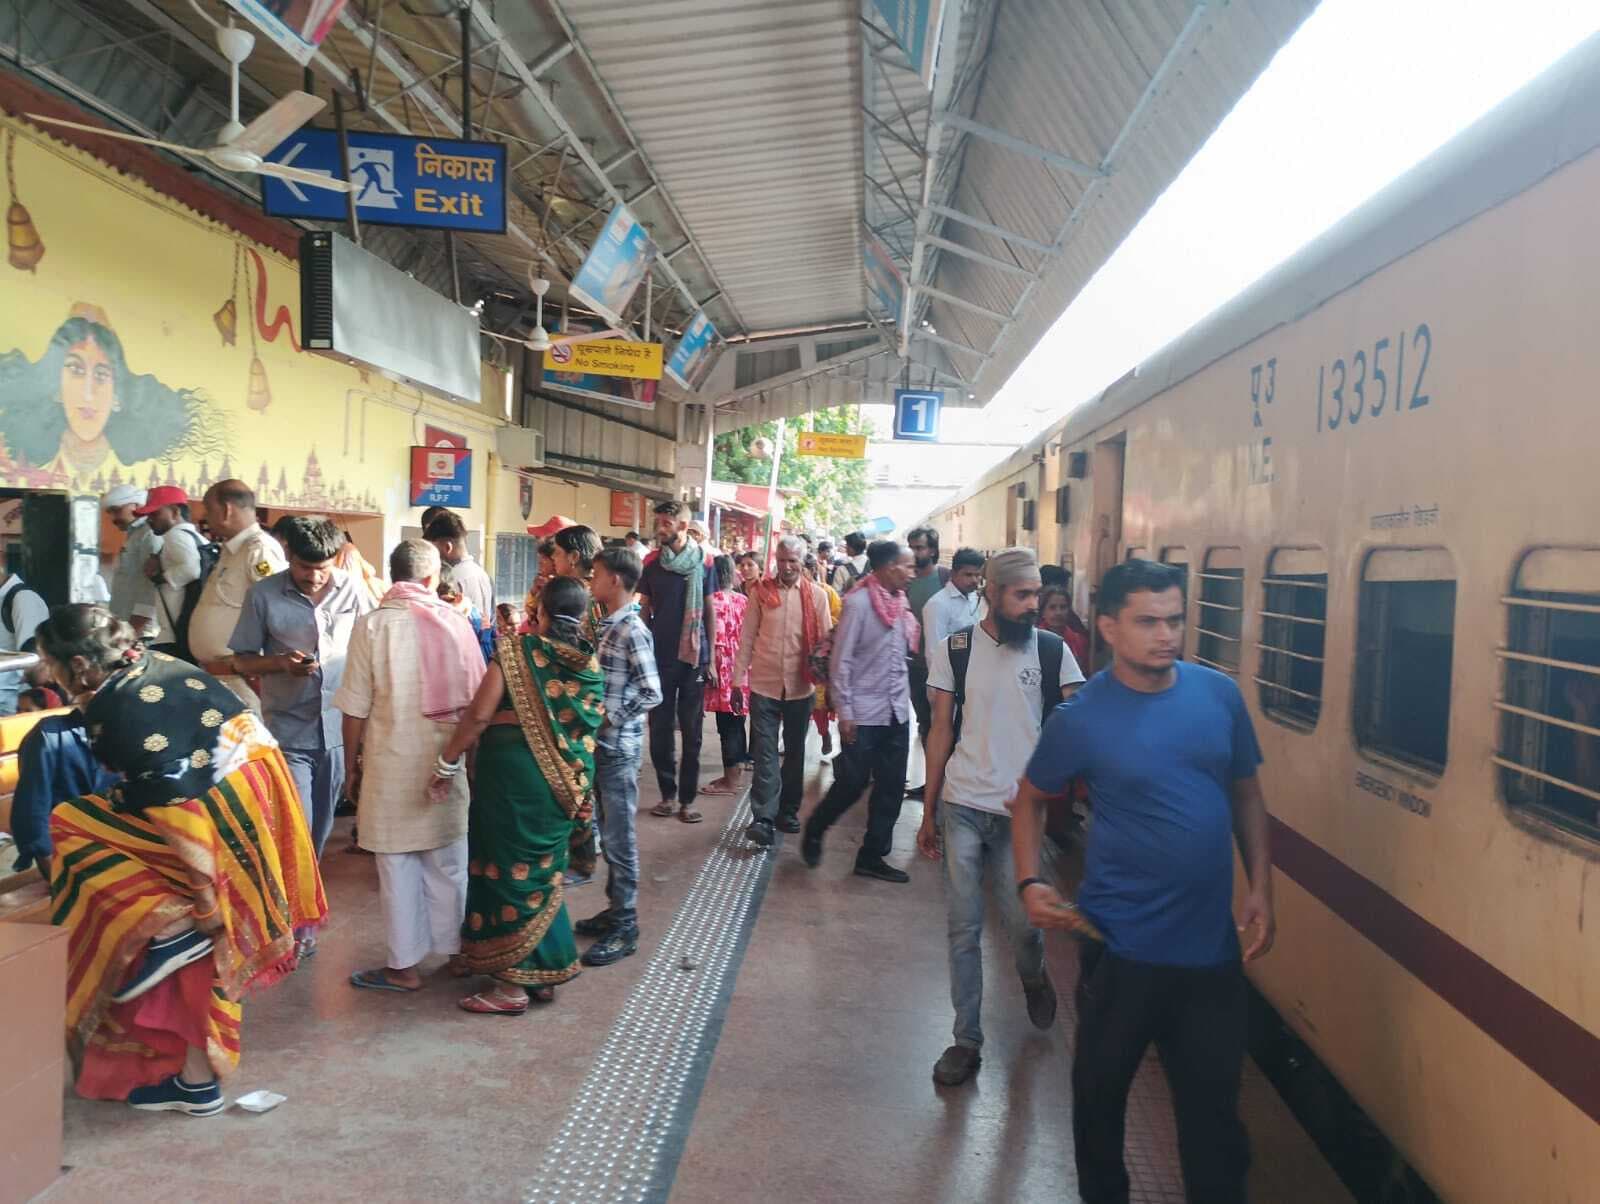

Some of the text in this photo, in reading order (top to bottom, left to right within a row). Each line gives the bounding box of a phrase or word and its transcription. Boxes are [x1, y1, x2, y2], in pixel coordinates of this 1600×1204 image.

[414, 143, 496, 183] निकास
[415, 188, 484, 216] Exit
[575, 357, 635, 373] No Smoking
[1316, 323, 1432, 433] 133512
[911, 399, 928, 431] 1
